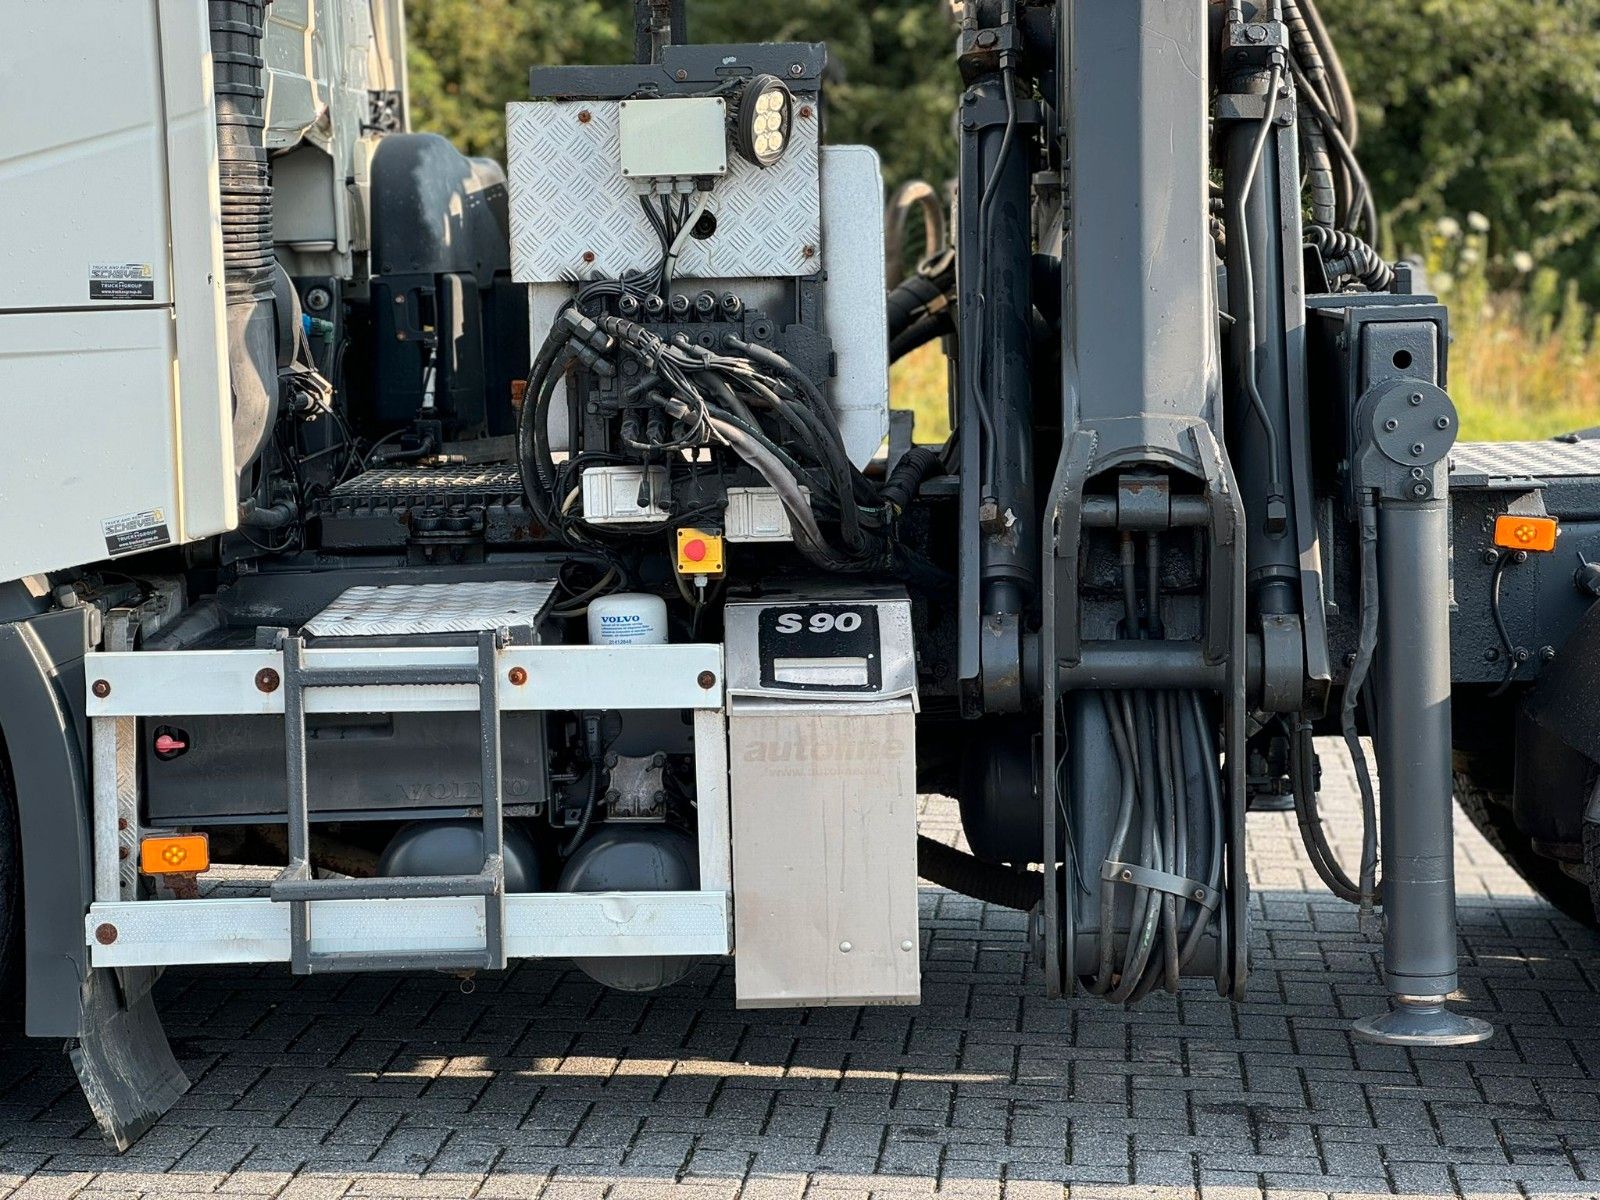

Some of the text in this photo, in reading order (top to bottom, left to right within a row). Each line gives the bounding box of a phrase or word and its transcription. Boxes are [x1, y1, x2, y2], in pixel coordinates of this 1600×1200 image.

[601, 615, 640, 623] VOLVO
[775, 611, 862, 634] S 90
[395, 777, 530, 801] VOLO
